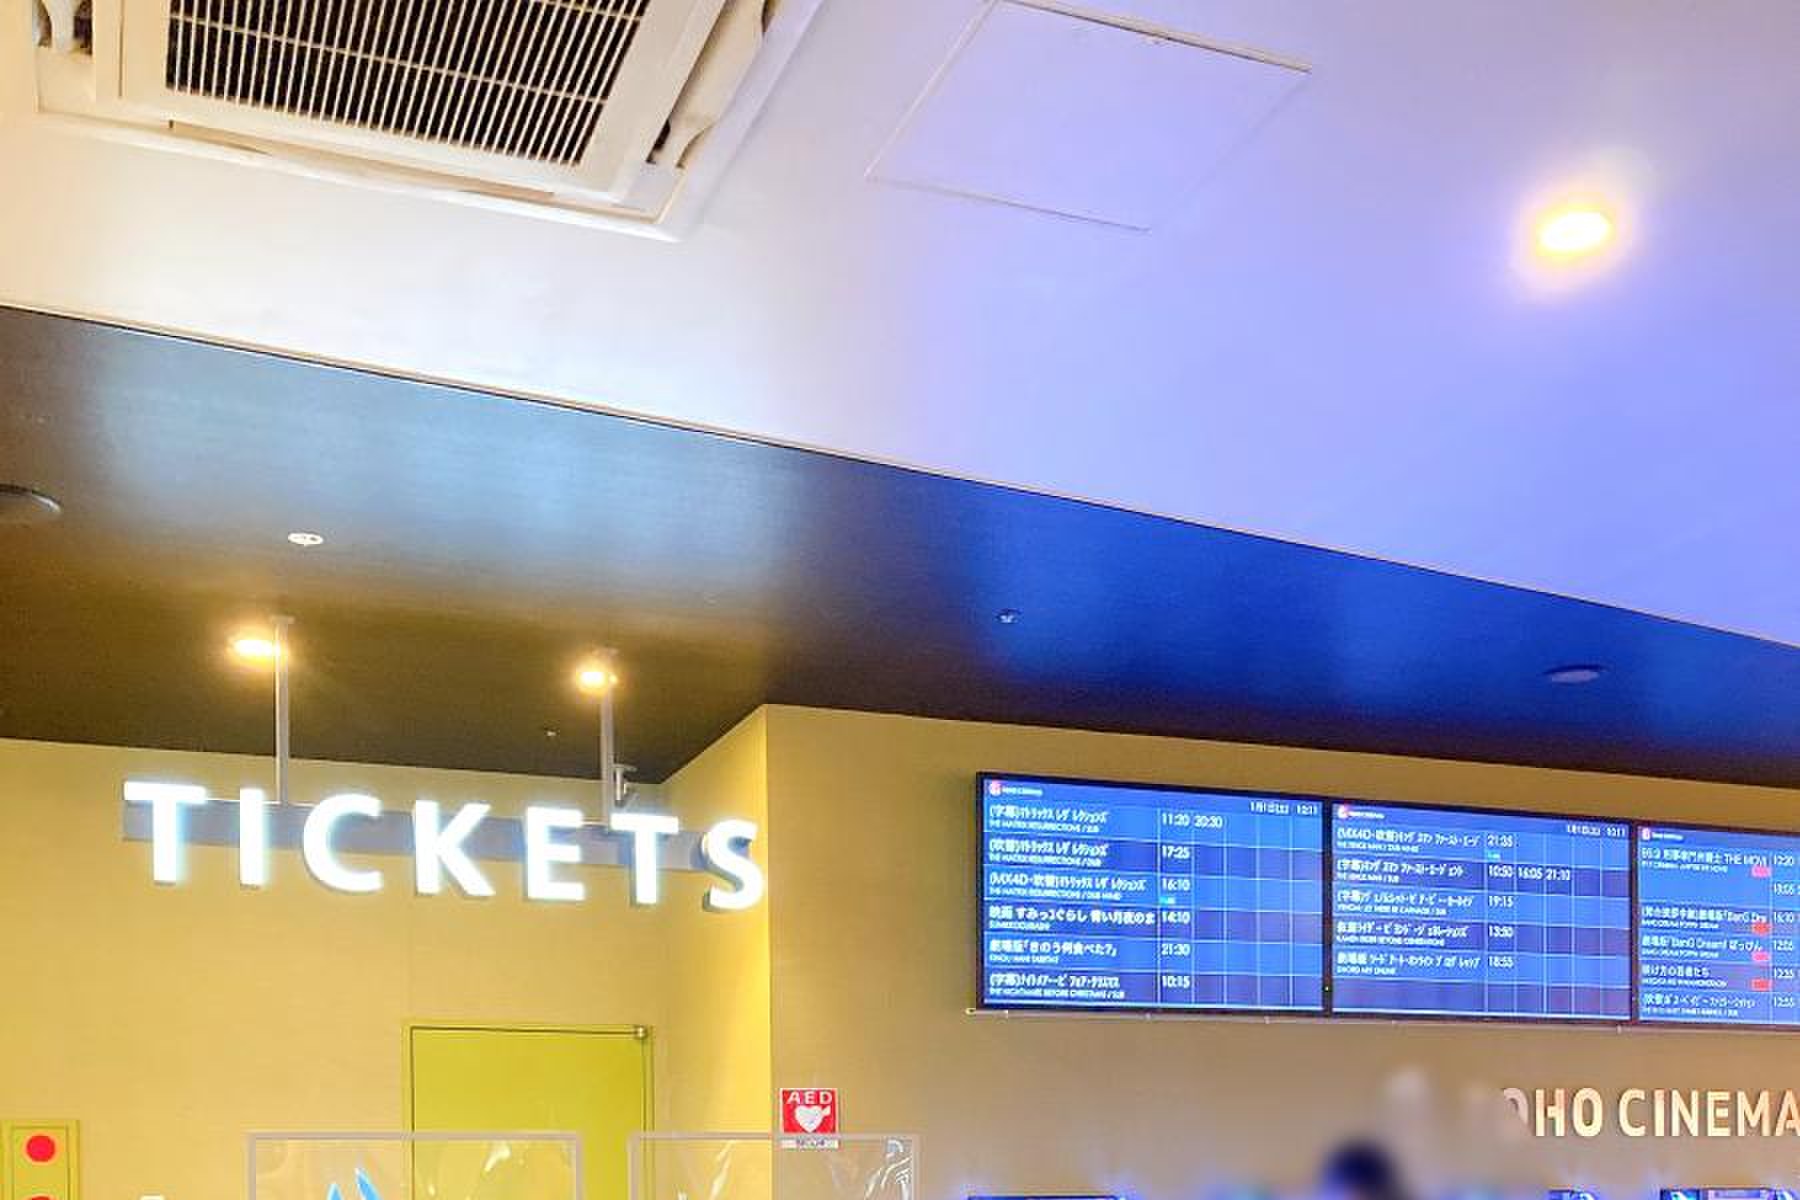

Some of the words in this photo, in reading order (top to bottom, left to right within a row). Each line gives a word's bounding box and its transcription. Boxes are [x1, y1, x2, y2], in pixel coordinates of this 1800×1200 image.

[1162, 812, 1190, 827] 11:20
[1194, 815, 1223, 828] 20:30
[123, 780, 765, 911] TICKETS
[1487, 835, 1513, 848] 21:35
[1162, 845, 1191, 859] 17:25
[1488, 864, 1513, 878] 10:50
[1518, 867, 1543, 880] 16:05
[1162, 878, 1191, 892] 16:10
[1488, 895, 1514, 908] 19:15
[1162, 911, 1191, 925] 14:10
[1488, 925, 1514, 938] 13:50
[1161, 943, 1191, 957] 21:30
[1162, 975, 1191, 989] 10:15
[786, 1090, 834, 1105] AED
